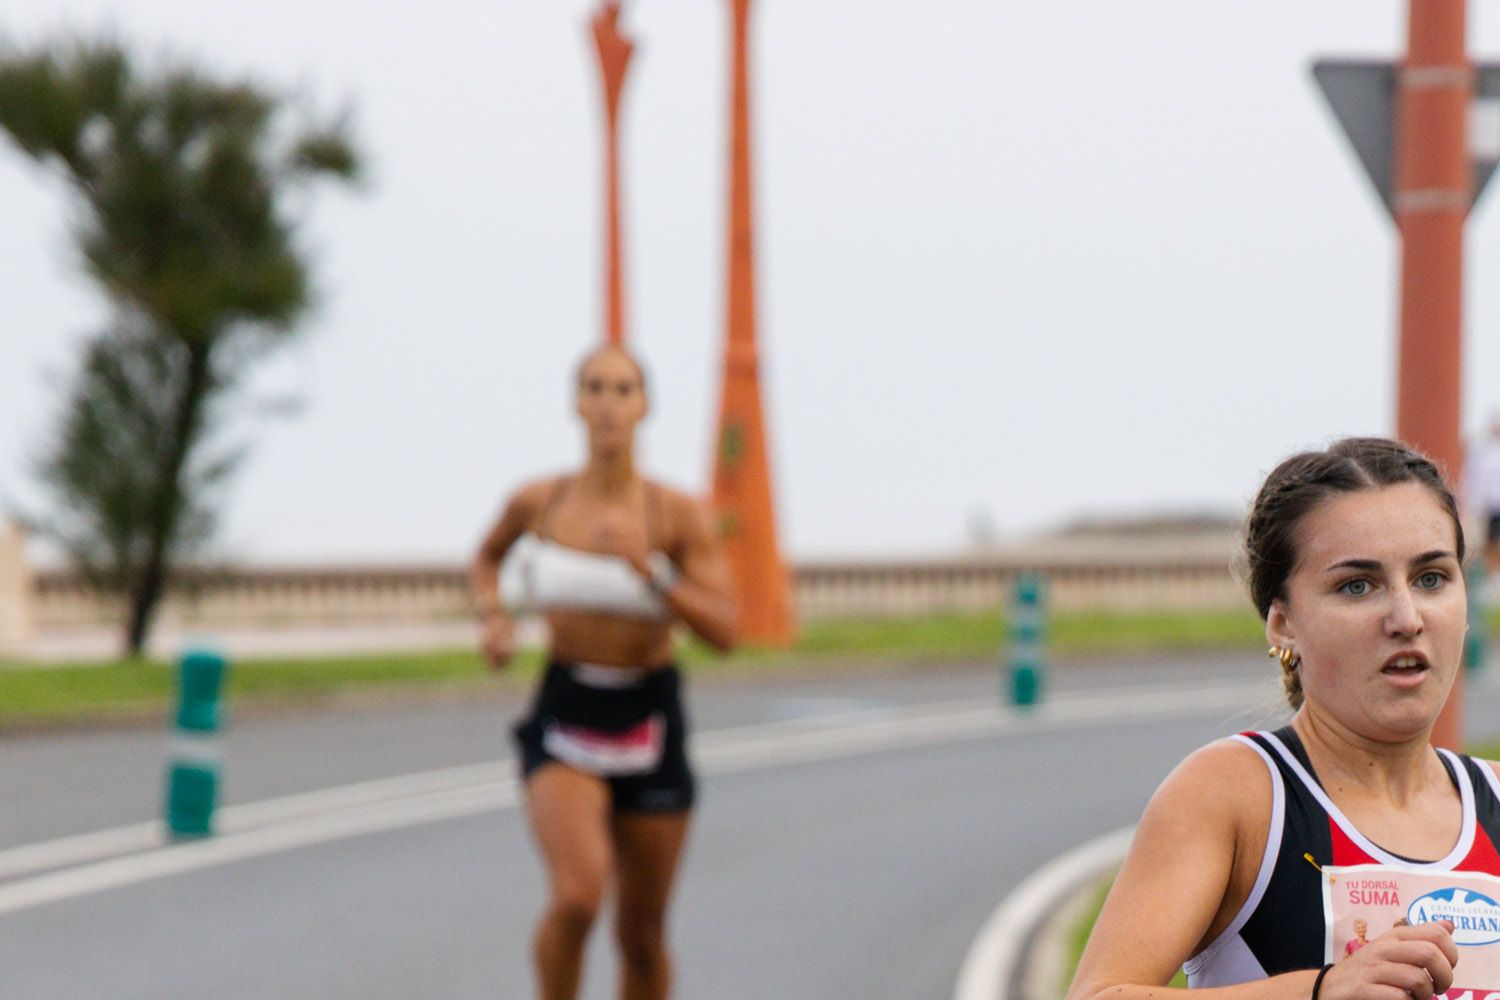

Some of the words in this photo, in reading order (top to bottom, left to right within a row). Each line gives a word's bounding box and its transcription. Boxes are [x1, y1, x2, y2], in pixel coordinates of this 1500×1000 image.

[1345, 880, 1359, 889] TU
[1361, 880, 1400, 890] DORSAL
[1349, 889, 1400, 907] SUMA
